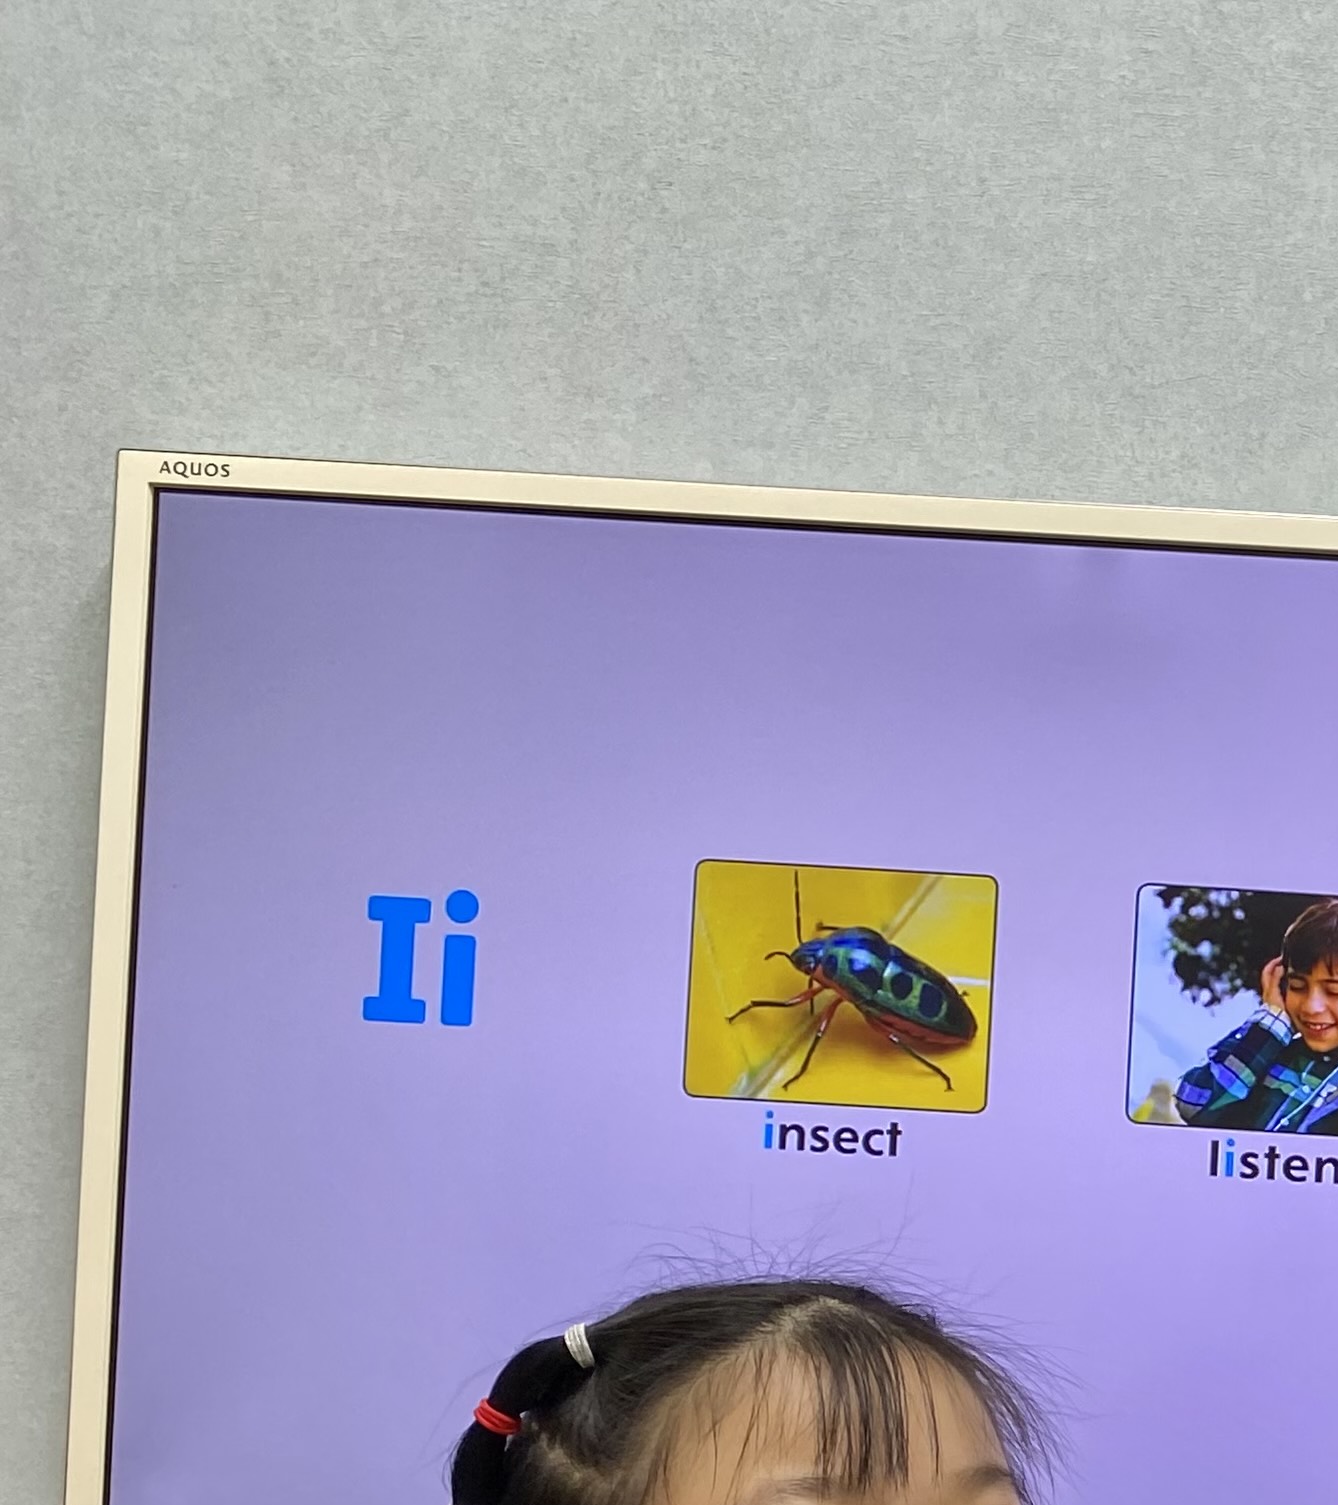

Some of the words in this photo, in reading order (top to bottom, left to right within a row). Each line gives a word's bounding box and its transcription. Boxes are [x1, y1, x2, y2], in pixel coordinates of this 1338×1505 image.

[159, 460, 231, 479] AQUOS
[362, 889, 480, 1027] Ii
[764, 1109, 903, 1158] insect
